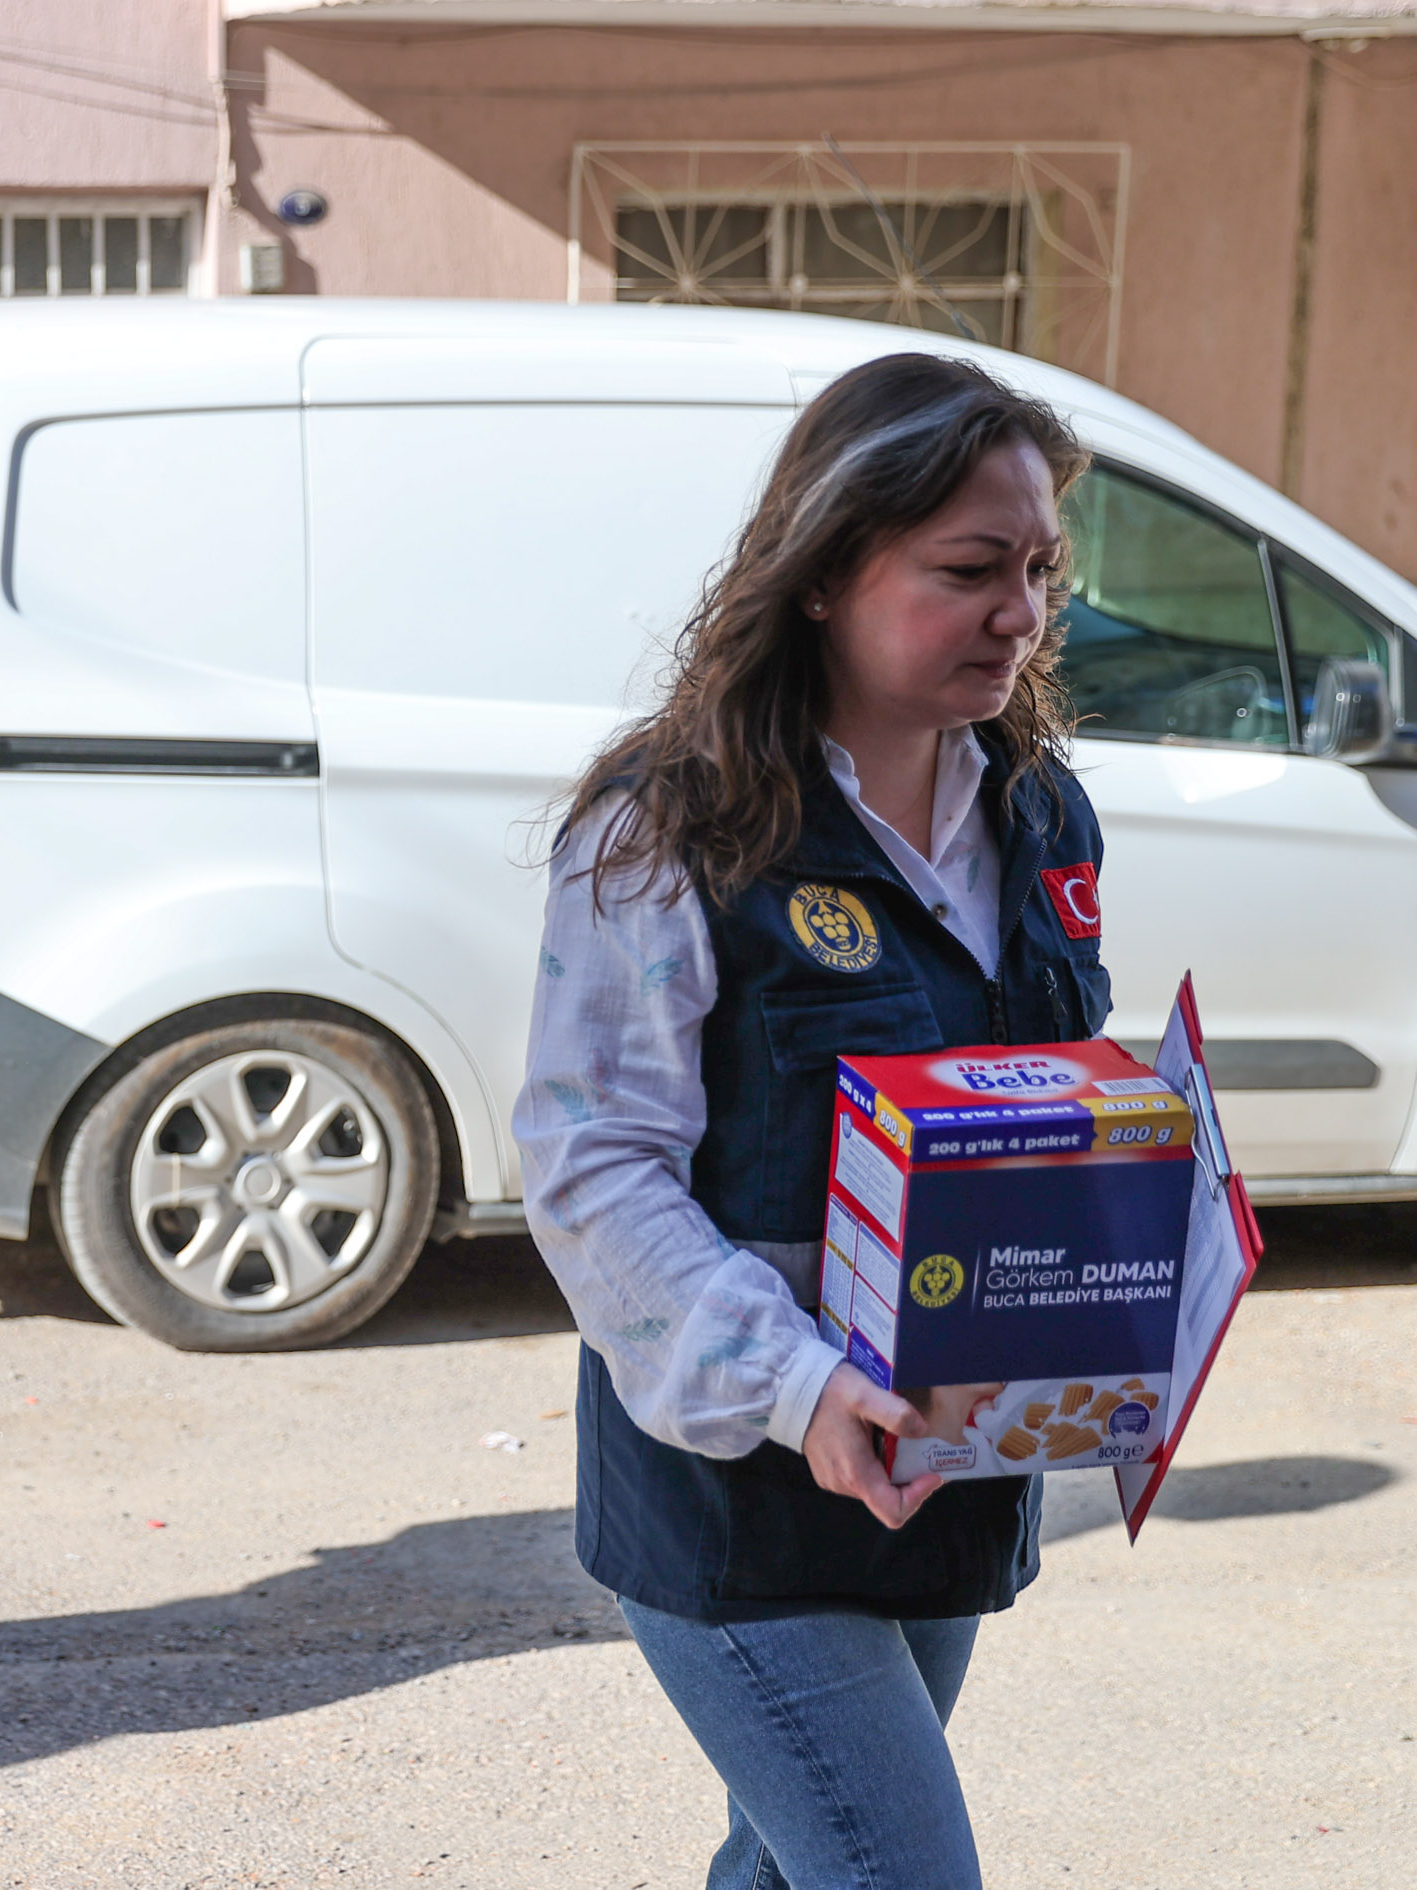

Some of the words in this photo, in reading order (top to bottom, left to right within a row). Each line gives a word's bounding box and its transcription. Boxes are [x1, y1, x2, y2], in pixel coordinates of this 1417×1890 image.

[794, 885, 840, 906] BUCA
[956, 1060, 1051, 1073] ÜLKER
[962, 1069, 1076, 1091] Bebe
[922, 1112, 955, 1121] 200
[1002, 1109, 1014, 1117] 4
[1018, 1106, 1074, 1116] paket
[1102, 1100, 1145, 1112] 800
[879, 1109, 898, 1137] 800
[929, 1142, 960, 1155] 200
[1008, 1138, 1020, 1149] 4
[1024, 1134, 1080, 1150] paket
[1108, 1125, 1152, 1145] 800
[1156, 1126, 1173, 1144] g
[989, 1245, 1066, 1267] Mimar
[986, 1268, 1074, 1289] Görkem
[1081, 1260, 1175, 1284] DUMAN
[983, 1295, 1024, 1308] BUCA
[1029, 1287, 1099, 1305] BELEDİYE
[1103, 1285, 1172, 1303] BAŞKANI
[933, 1449, 958, 1458] TRANS
[1097, 1445, 1122, 1459] 800
